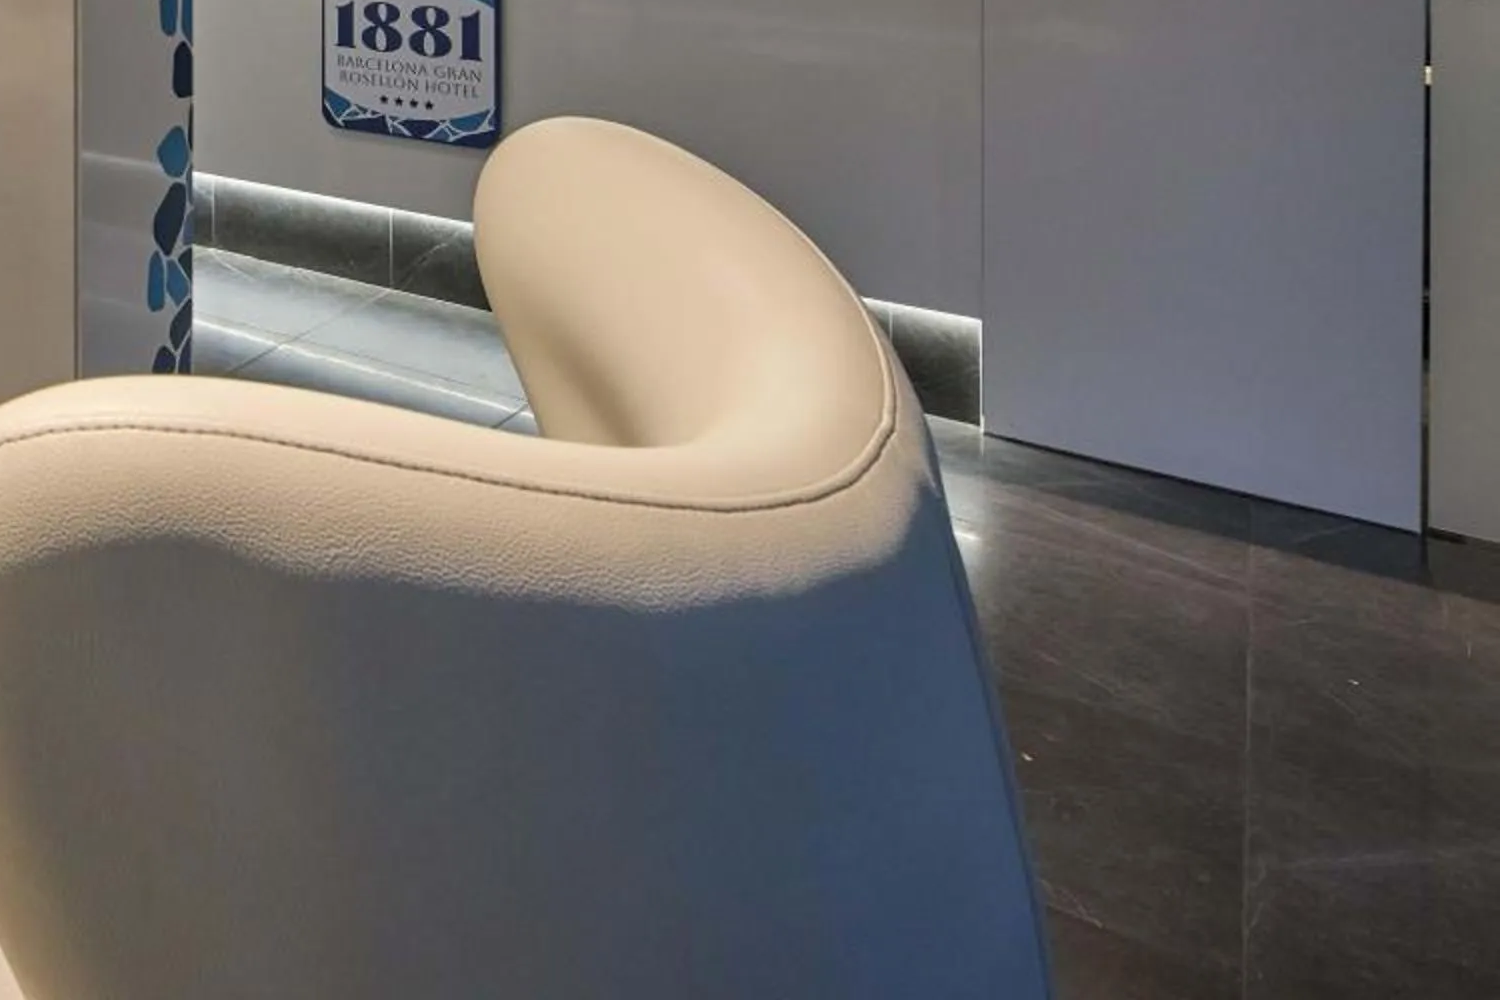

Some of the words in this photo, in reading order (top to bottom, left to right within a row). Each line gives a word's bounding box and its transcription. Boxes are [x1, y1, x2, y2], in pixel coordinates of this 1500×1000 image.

[334, 0, 483, 63] 1881
[336, 53, 428, 77] BARCELONA
[433, 66, 483, 84] GRAN
[425, 80, 480, 99] HOTEL
